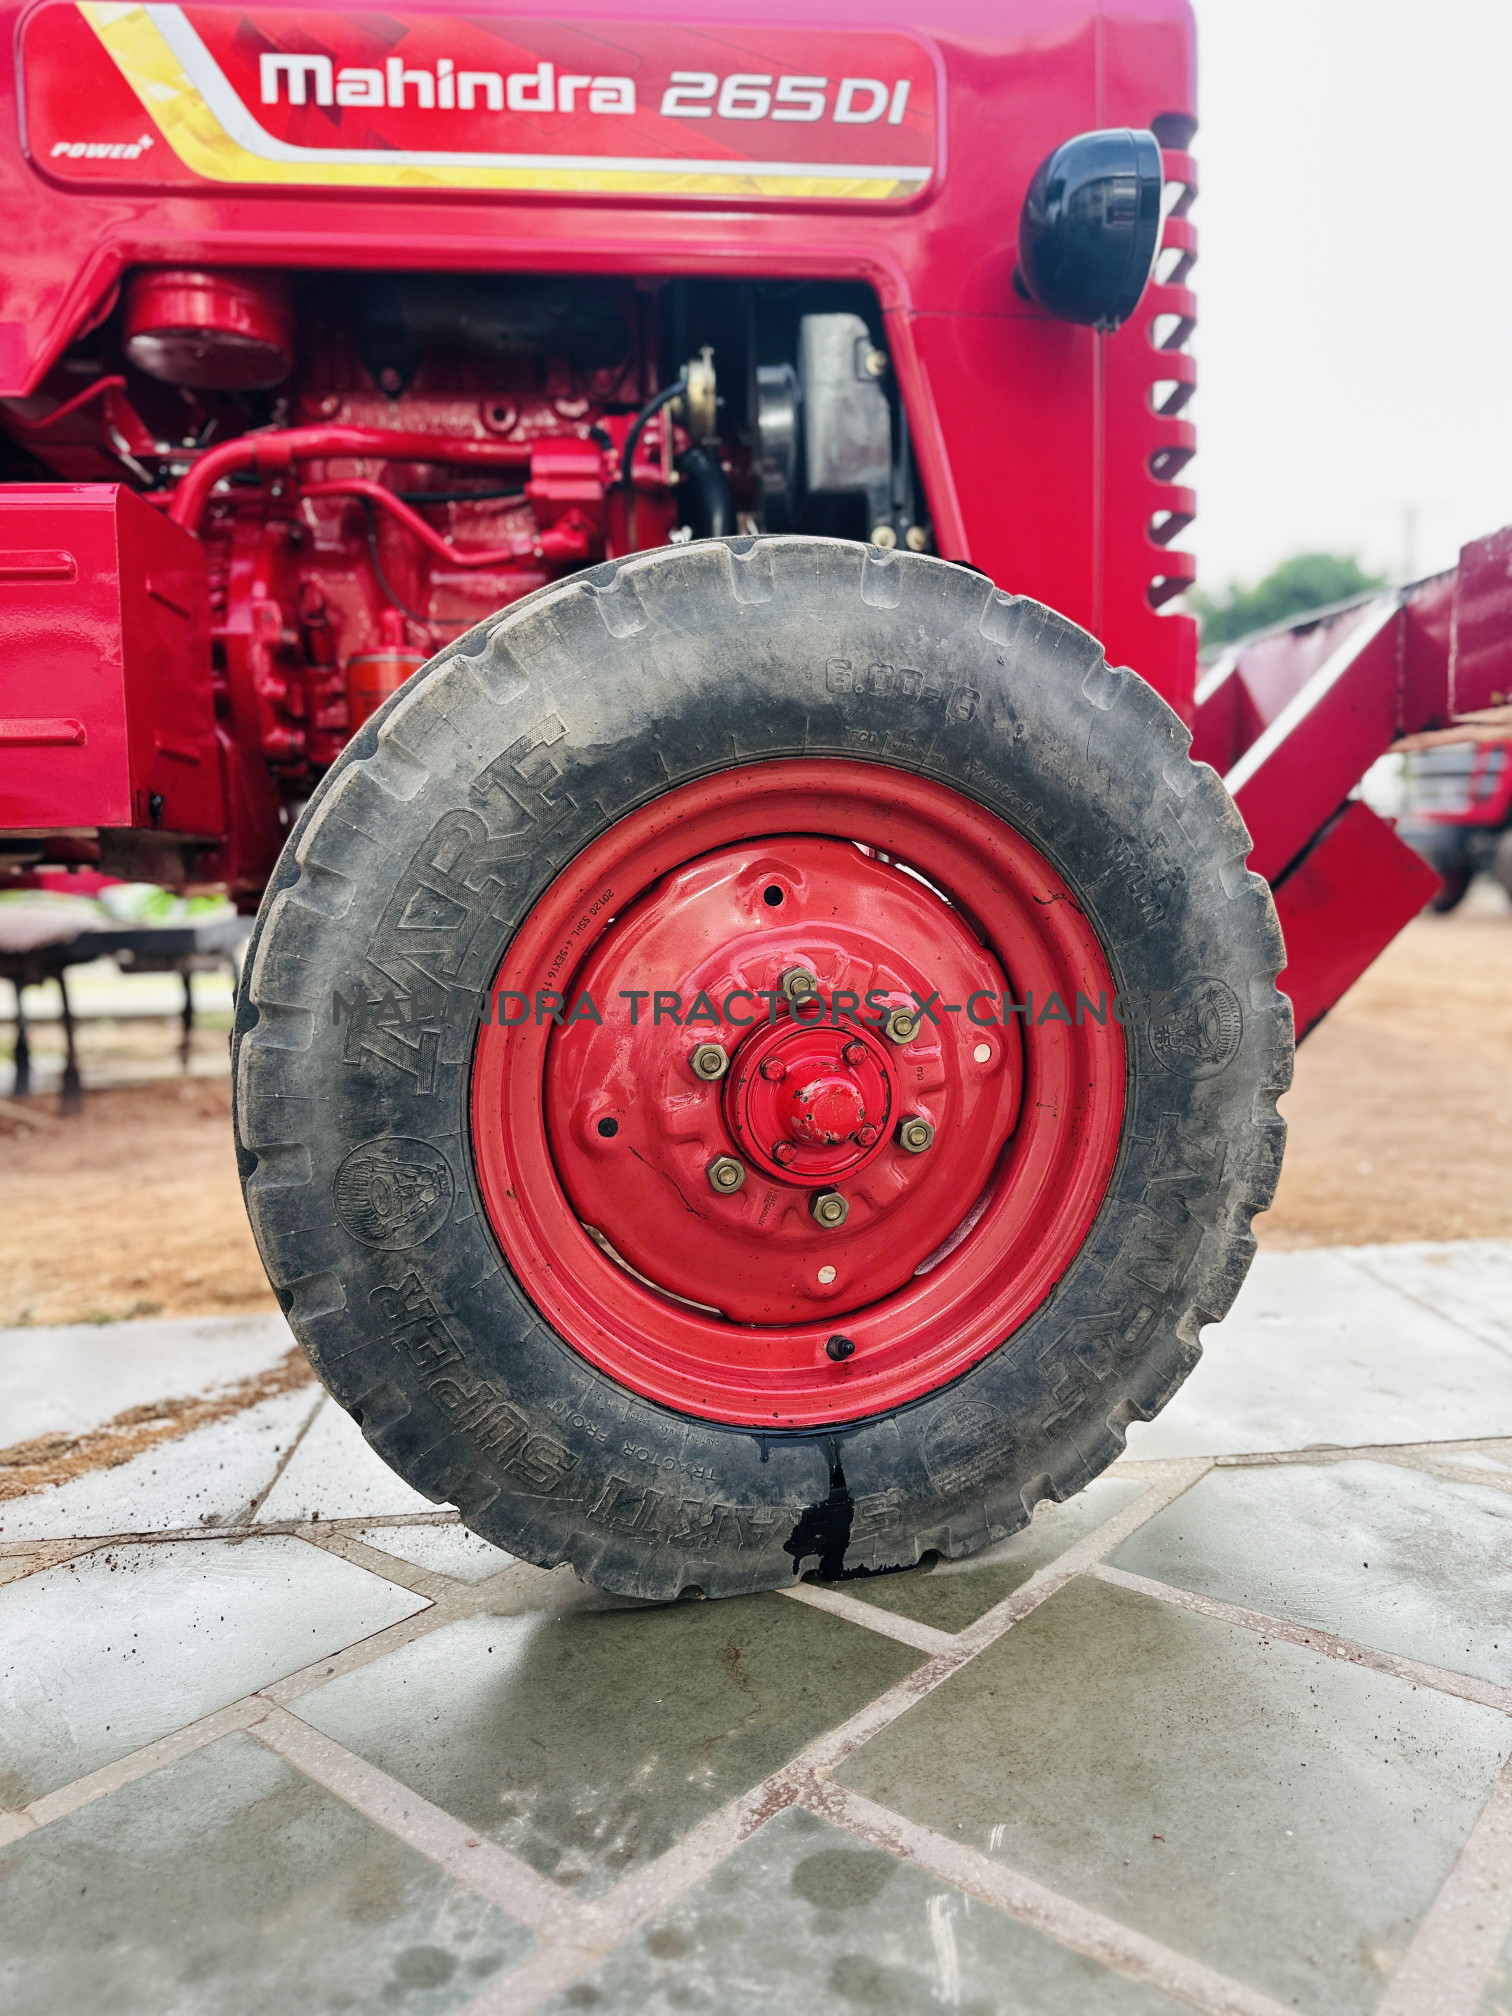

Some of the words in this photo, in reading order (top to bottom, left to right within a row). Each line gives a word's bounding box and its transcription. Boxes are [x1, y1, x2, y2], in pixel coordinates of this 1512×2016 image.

[259, 52, 636, 114] Mahindra
[660, 71, 828, 122] 265
[832, 78, 911, 125] DI
[343, 711, 579, 1095] MRF
[1105, 837, 1166, 928] NYLON
[1037, 1113, 1228, 1444] MRF
[369, 1271, 580, 1491] SUPER
[548, 1399, 609, 1442] FRONT
[622, 1440, 717, 1482] TRACTOR
[586, 1475, 901, 1551] SAKTI
